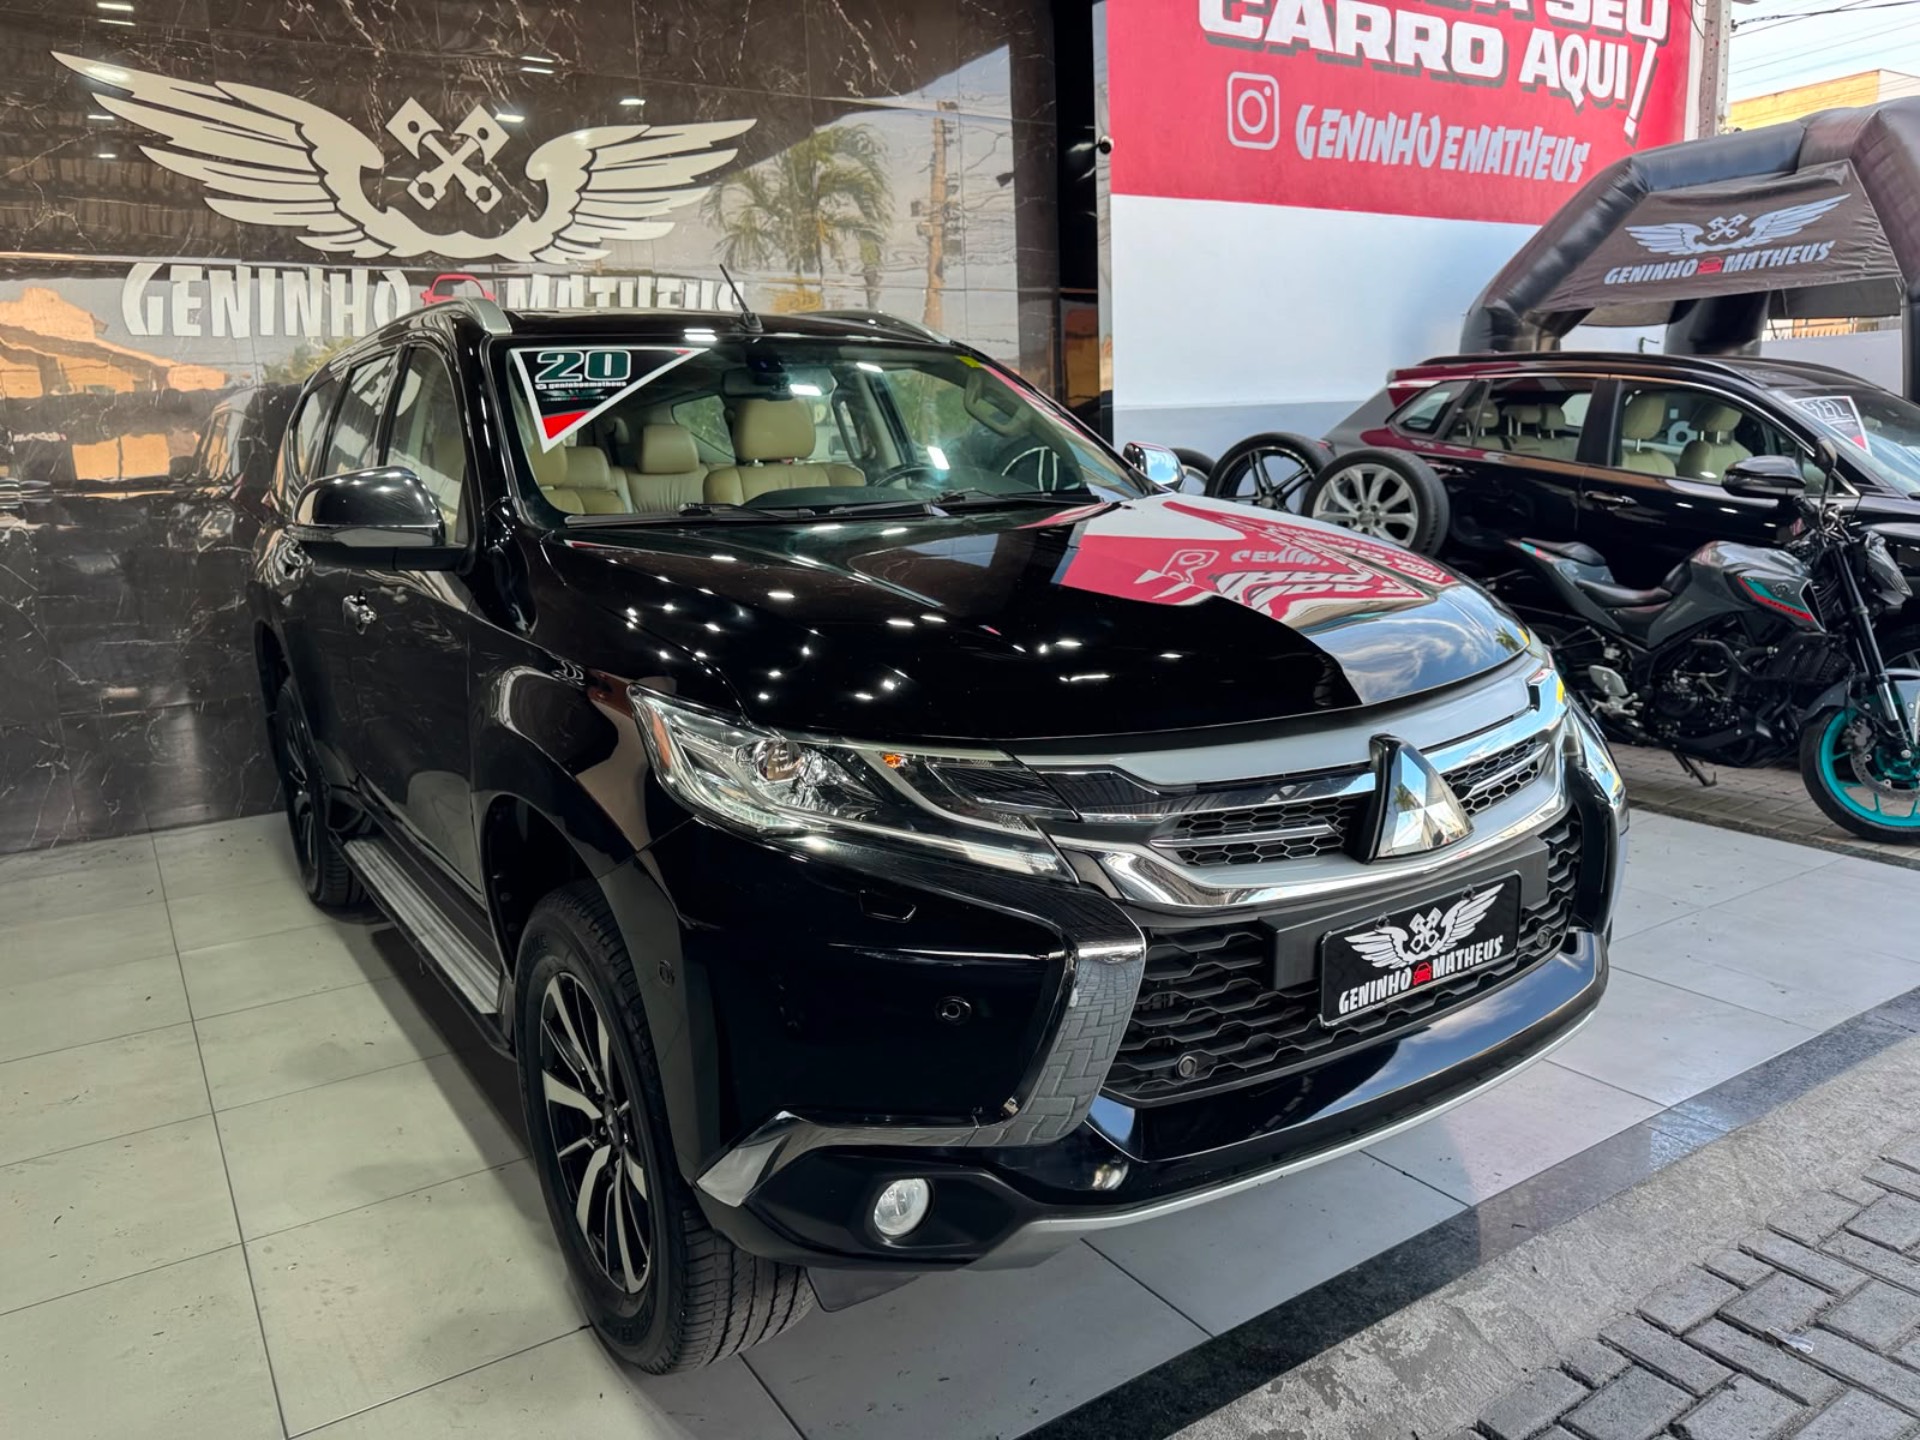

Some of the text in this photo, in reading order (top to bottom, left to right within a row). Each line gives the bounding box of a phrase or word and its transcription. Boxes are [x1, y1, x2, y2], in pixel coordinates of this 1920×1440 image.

[1199, 0, 1504, 78] CARRO
[121, 262, 412, 338] GENINHO
[1603, 240, 1836, 285] GENINHO MATHEUS
[535, 350, 632, 383] 20
[1338, 935, 1504, 1016] GENINHO MATHEUS
